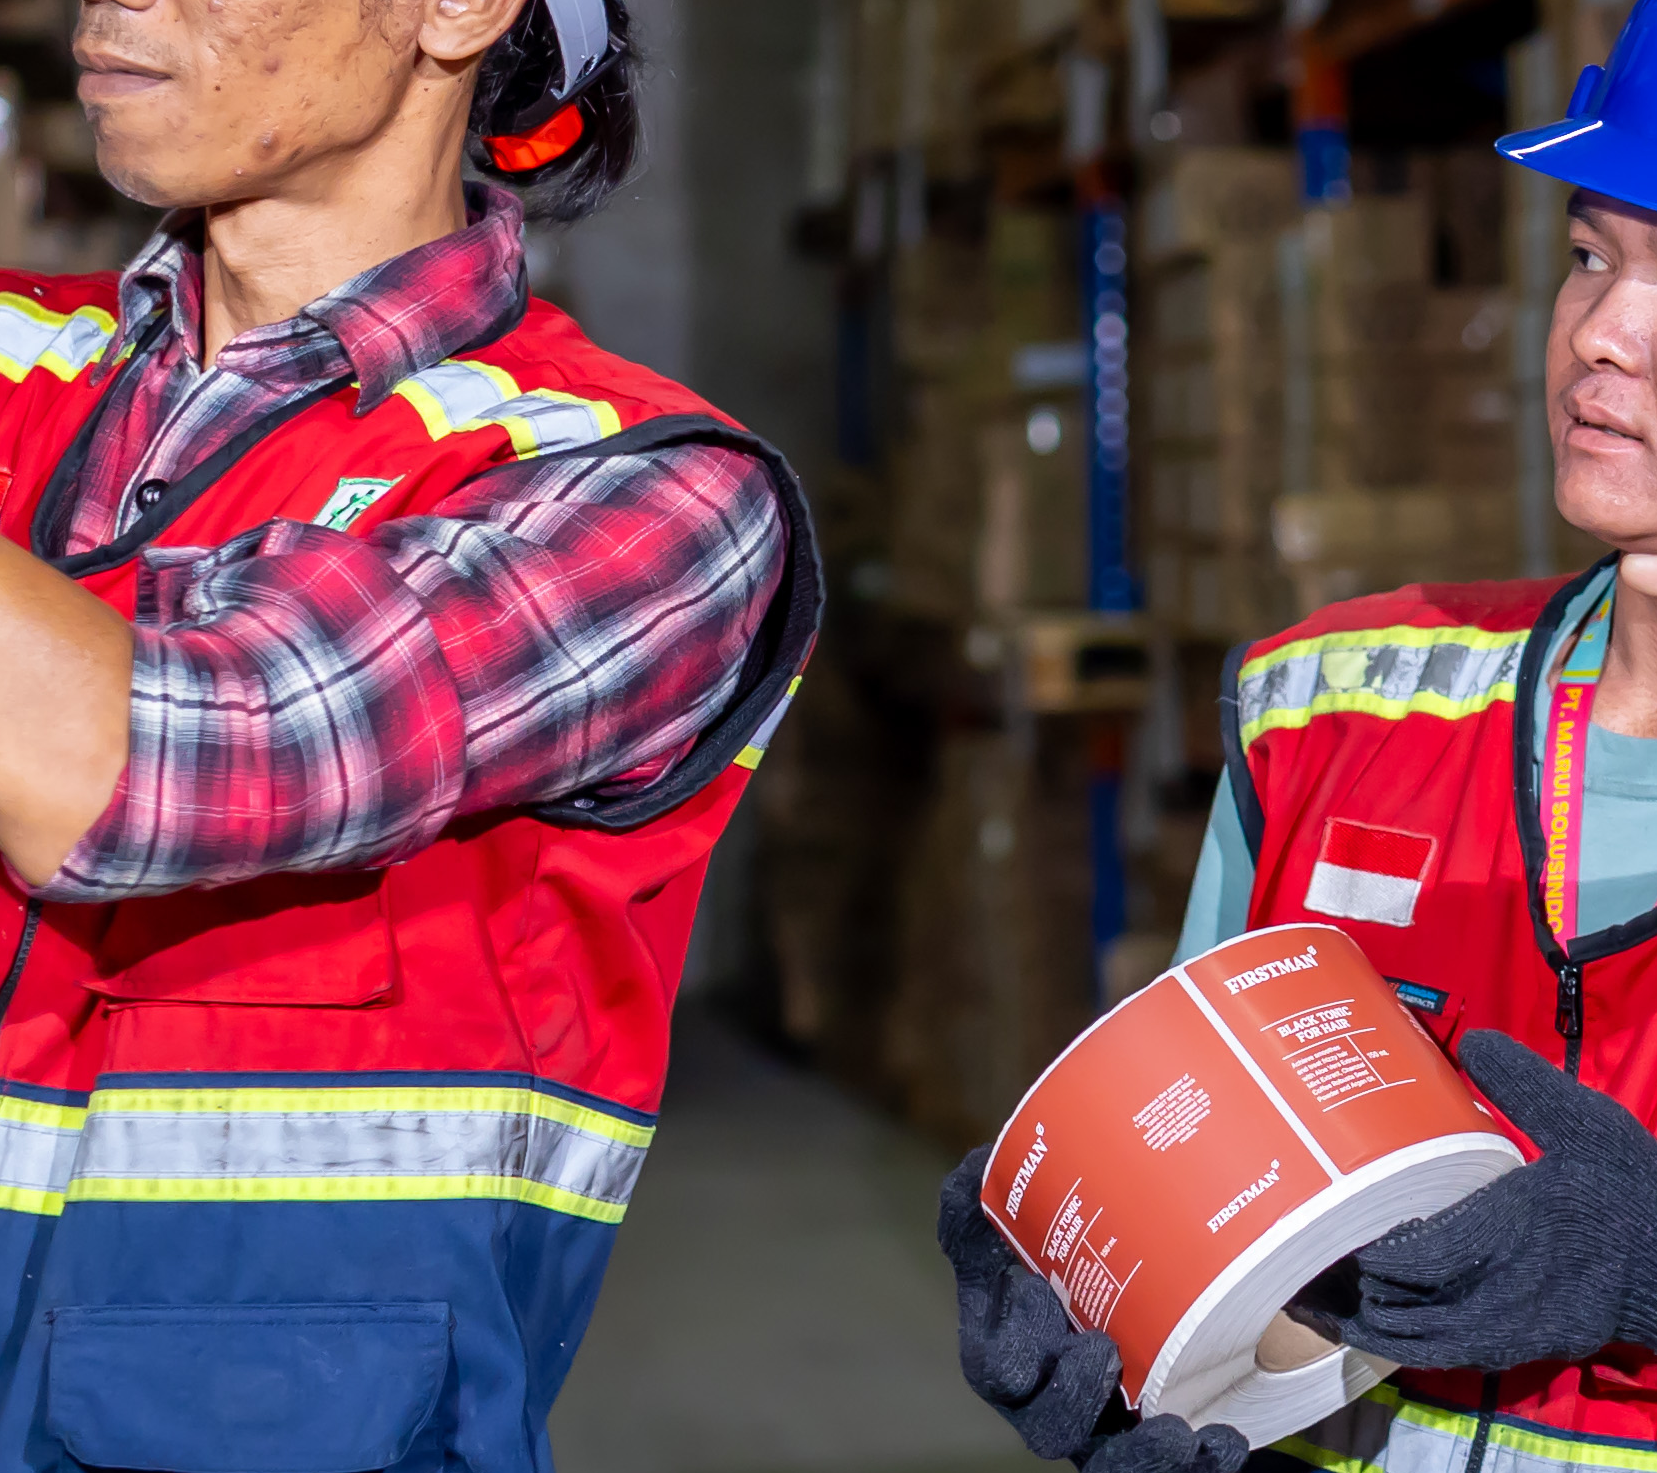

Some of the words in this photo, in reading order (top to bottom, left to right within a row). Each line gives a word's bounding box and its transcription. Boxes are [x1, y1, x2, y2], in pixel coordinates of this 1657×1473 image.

[1553, 720, 1576, 798] MARUI
[1545, 801, 1570, 935] SOLUSINDO
[1223, 953, 1319, 996] FIRSTMAN
[1276, 1013, 1316, 1039] BLACK
[1315, 1005, 1353, 1025] TONIC
[1295, 1026, 1322, 1044] FOR
[1321, 1018, 1351, 1037] HAIR
[1005, 1137, 1048, 1220] FIRSTMAN
[1206, 1168, 1280, 1234] FIRSTMAN
[1046, 1227, 1066, 1262] BLACK
[1060, 1194, 1083, 1231] TONIC
[1056, 1241, 1073, 1264] FOR
[1065, 1214, 1085, 1242] HAIR
